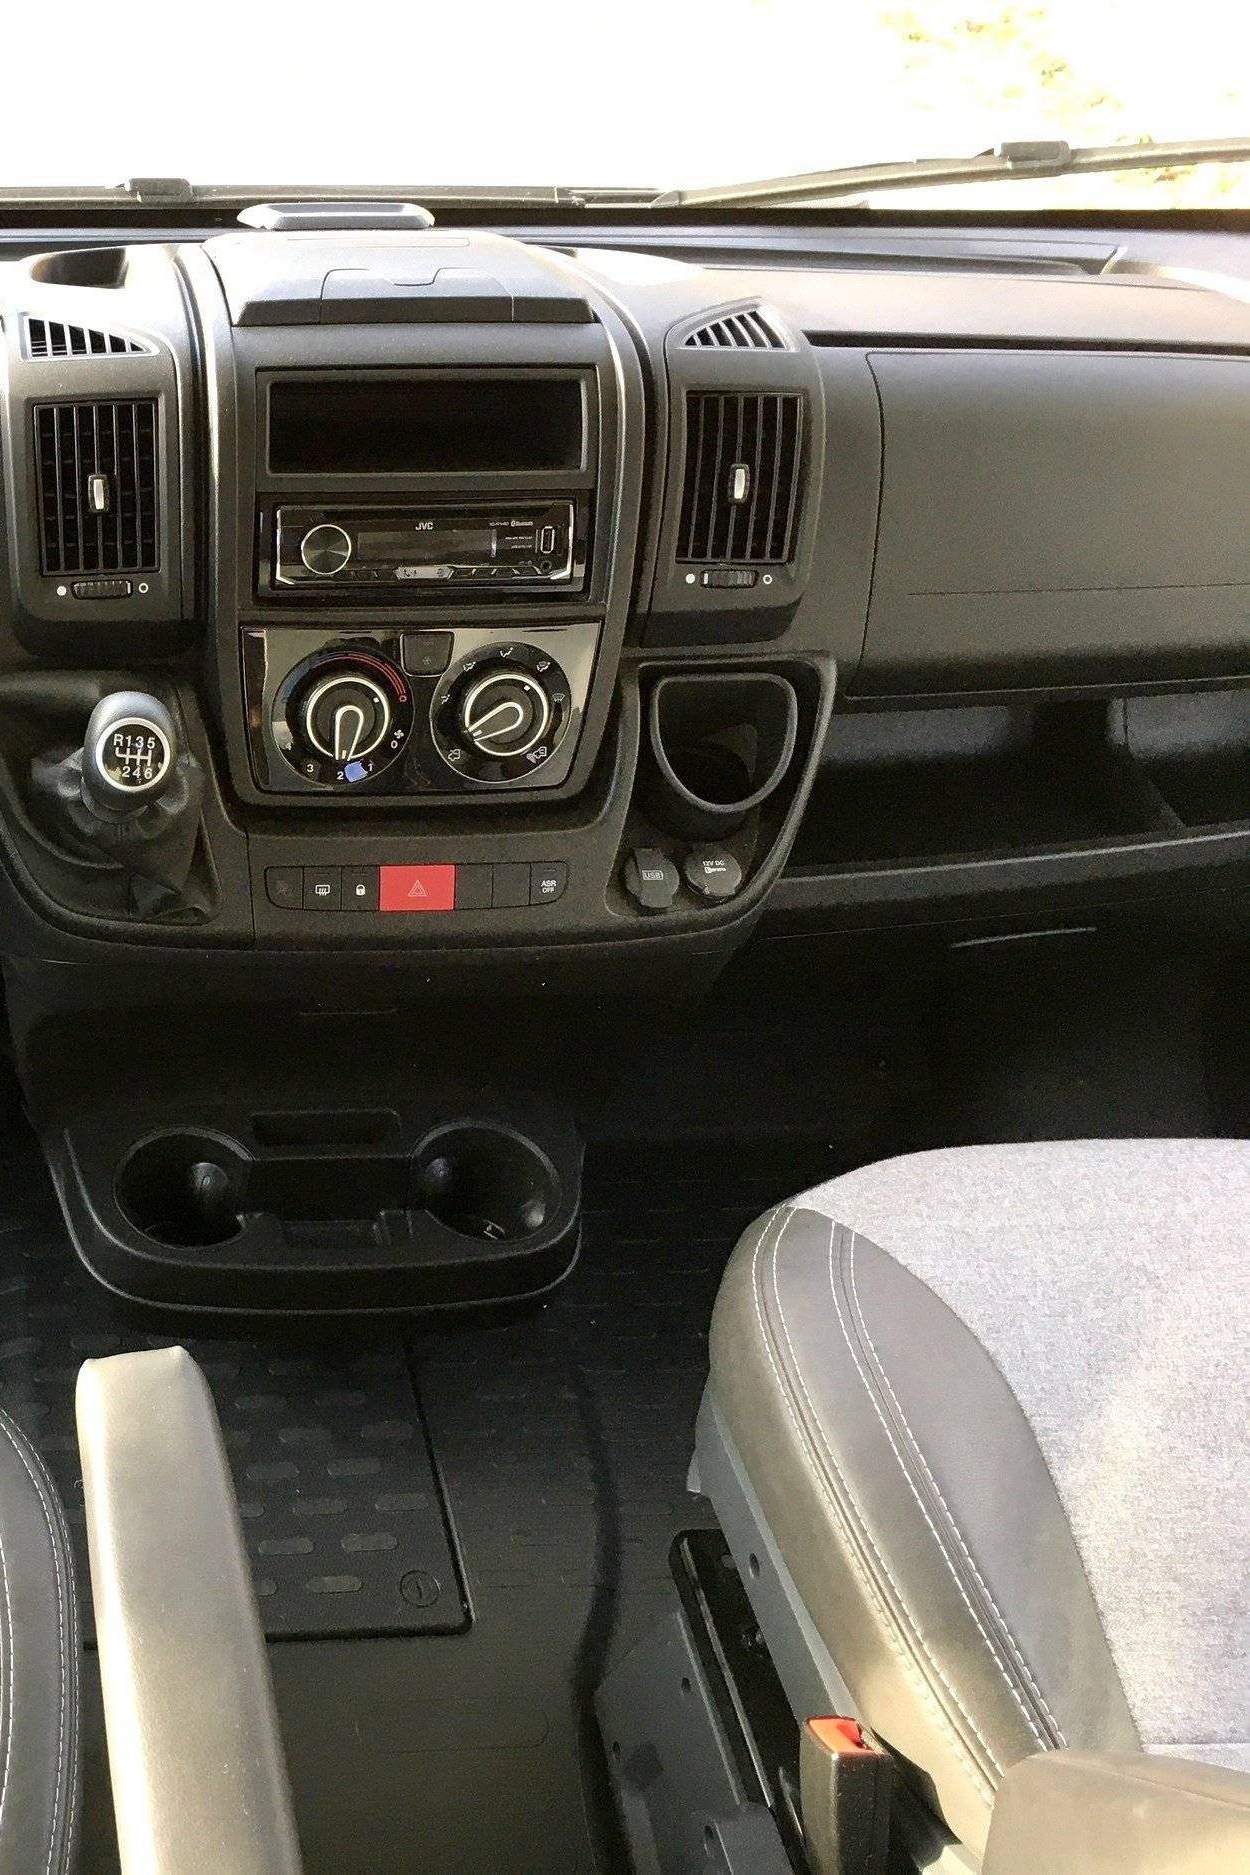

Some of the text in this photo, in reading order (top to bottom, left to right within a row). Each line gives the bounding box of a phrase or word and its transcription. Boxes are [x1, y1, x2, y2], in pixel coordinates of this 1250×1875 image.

[415, 521, 434, 531] JVC
[306, 764, 314, 773] 3
[336, 771, 344, 780] 2
[643, 871, 661, 880] USB
[540, 879, 557, 887] ASR
